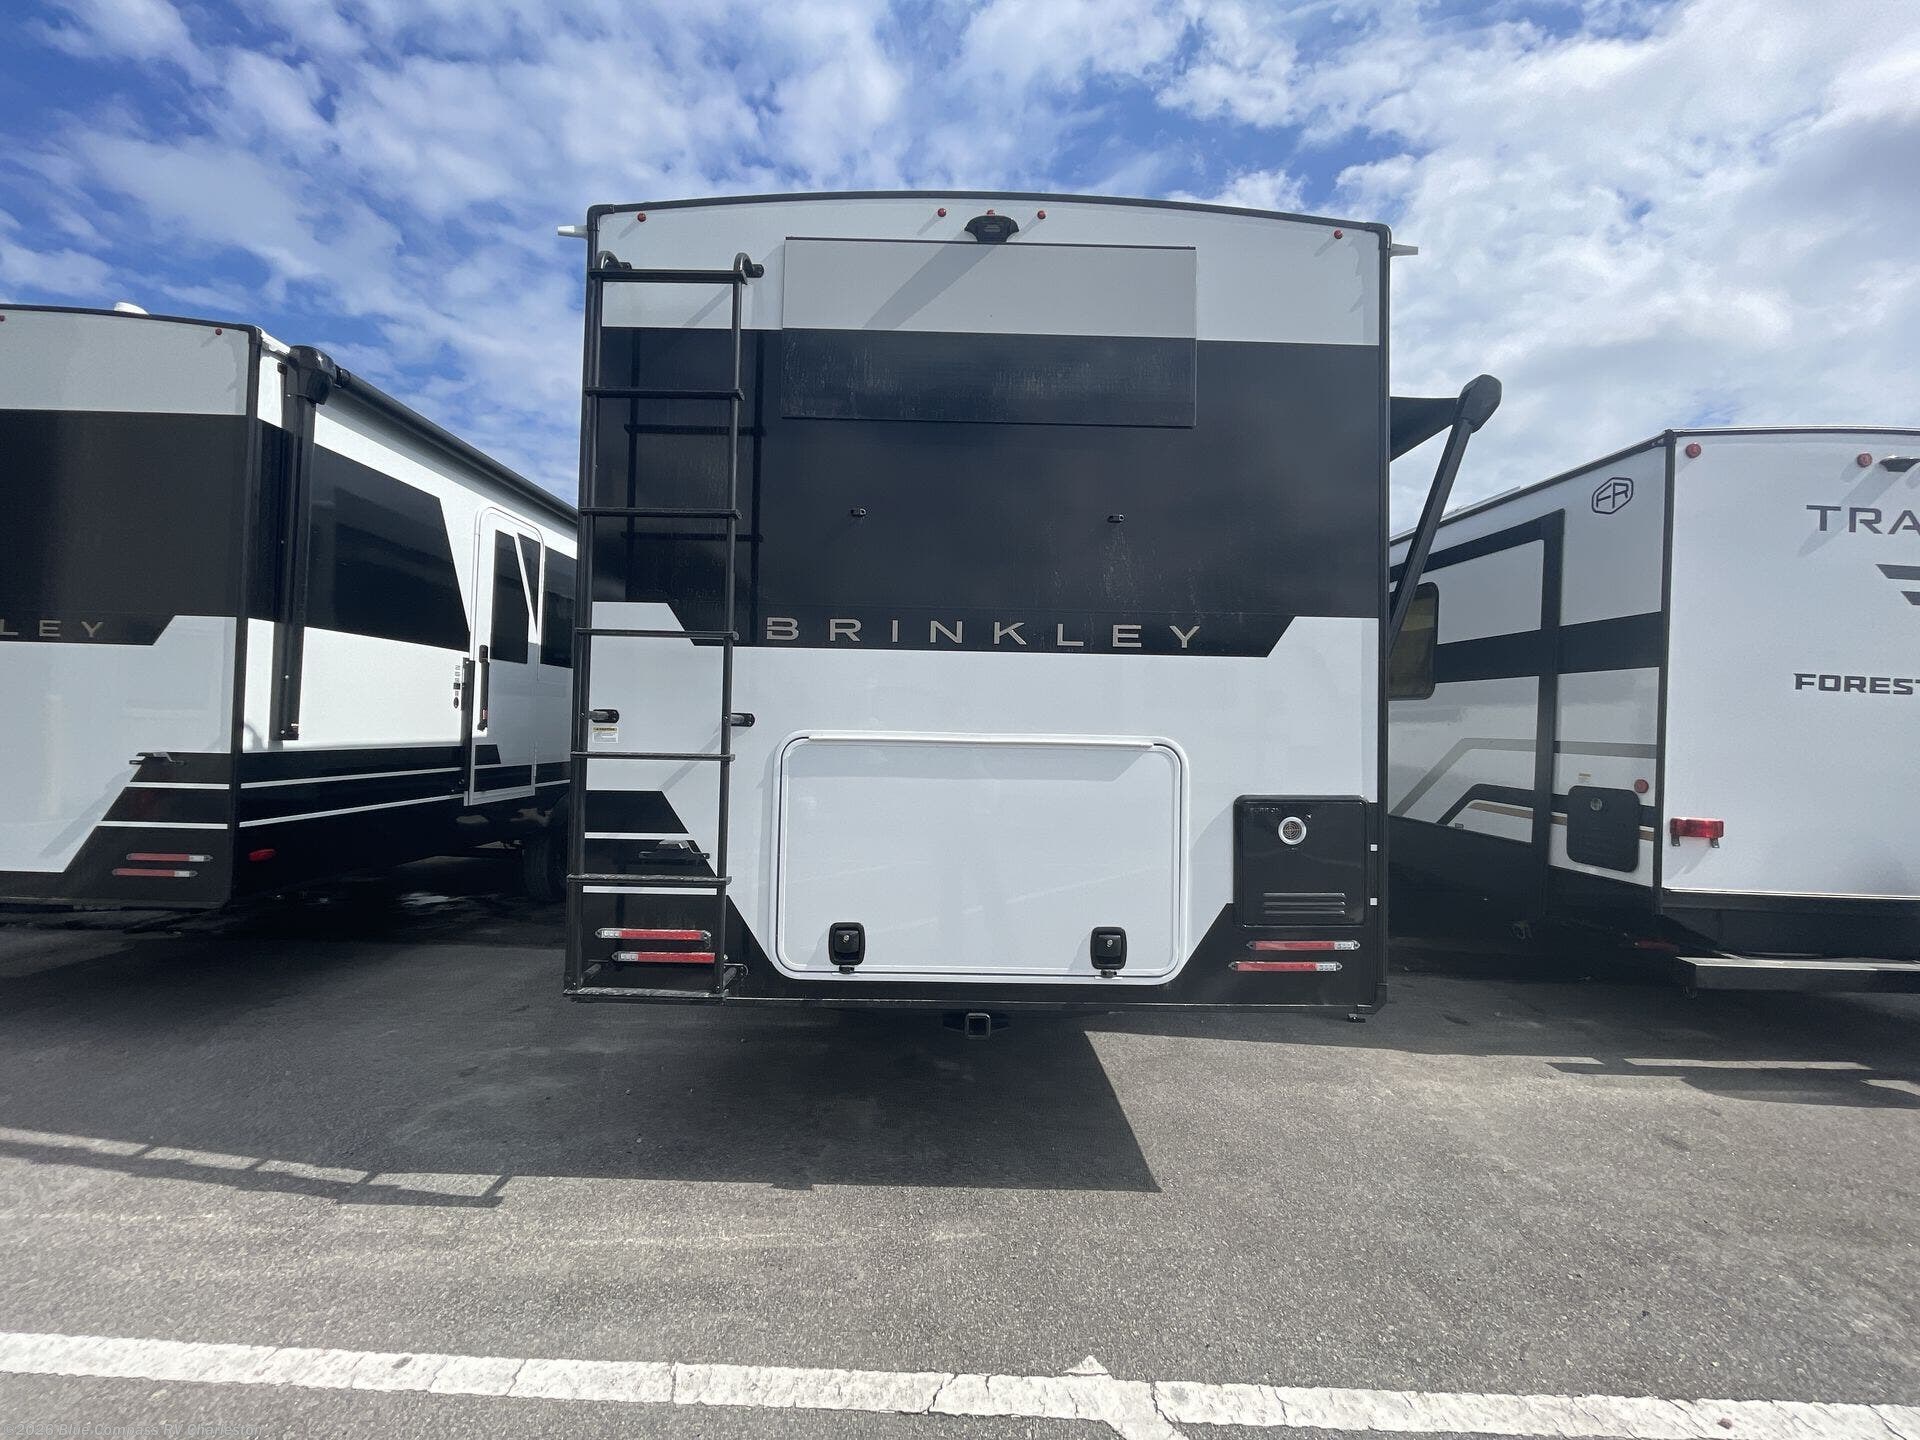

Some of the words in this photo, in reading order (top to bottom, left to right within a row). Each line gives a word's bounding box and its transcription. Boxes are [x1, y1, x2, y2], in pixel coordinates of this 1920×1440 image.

[1806, 504, 1920, 535] TRA
[766, 616, 1201, 649] BRINKLEY
[1793, 672, 1920, 696] FORES
